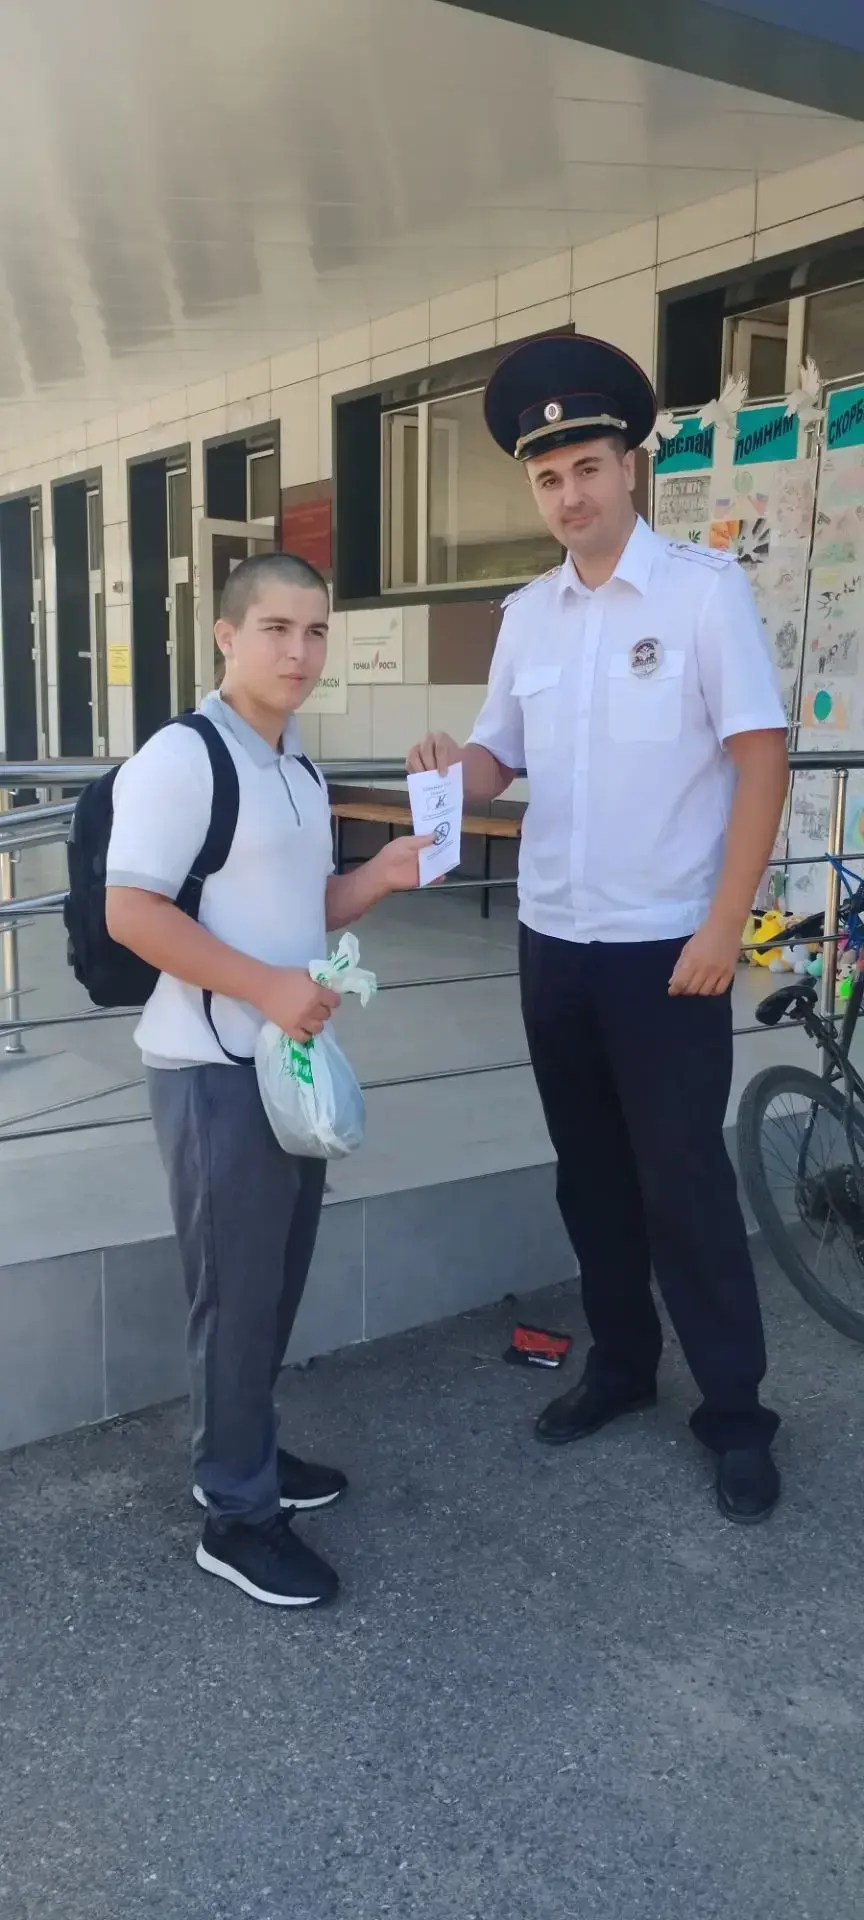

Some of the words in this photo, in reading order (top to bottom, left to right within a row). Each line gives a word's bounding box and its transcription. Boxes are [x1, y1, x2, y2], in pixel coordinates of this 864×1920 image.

[352, 661, 371, 671] ТОЧКА
[378, 660, 398, 670] РОСТА
[316, 677, 340, 688] ЛАССЫ
